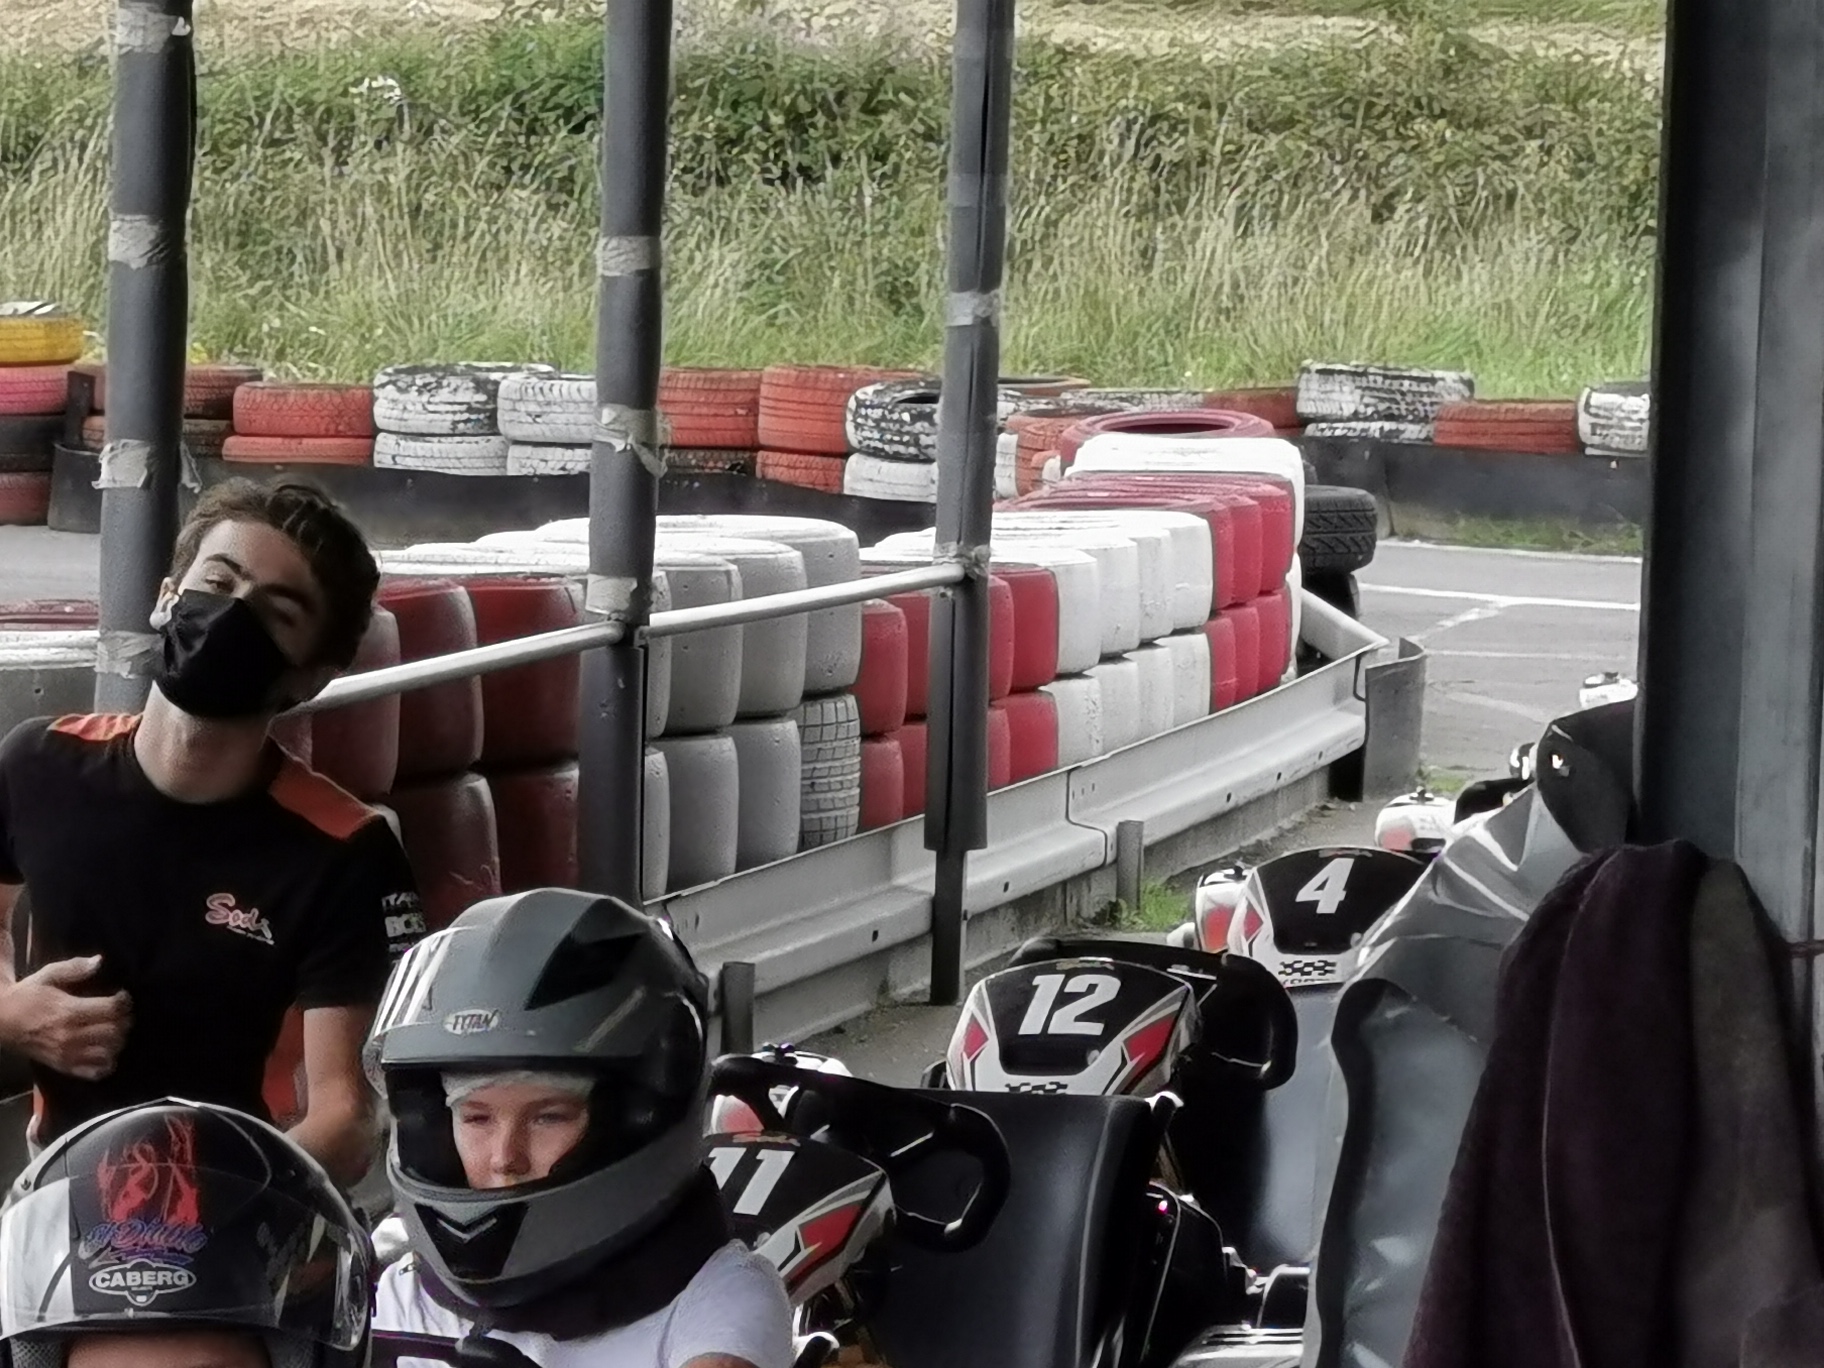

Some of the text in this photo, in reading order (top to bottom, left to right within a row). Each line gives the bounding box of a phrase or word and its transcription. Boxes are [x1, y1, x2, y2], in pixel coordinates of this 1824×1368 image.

[1295, 858, 1354, 914] 4
[1018, 974, 1121, 1035] 12
[708, 1147, 795, 1215] 11
[95, 1271, 189, 1288] CABERG
